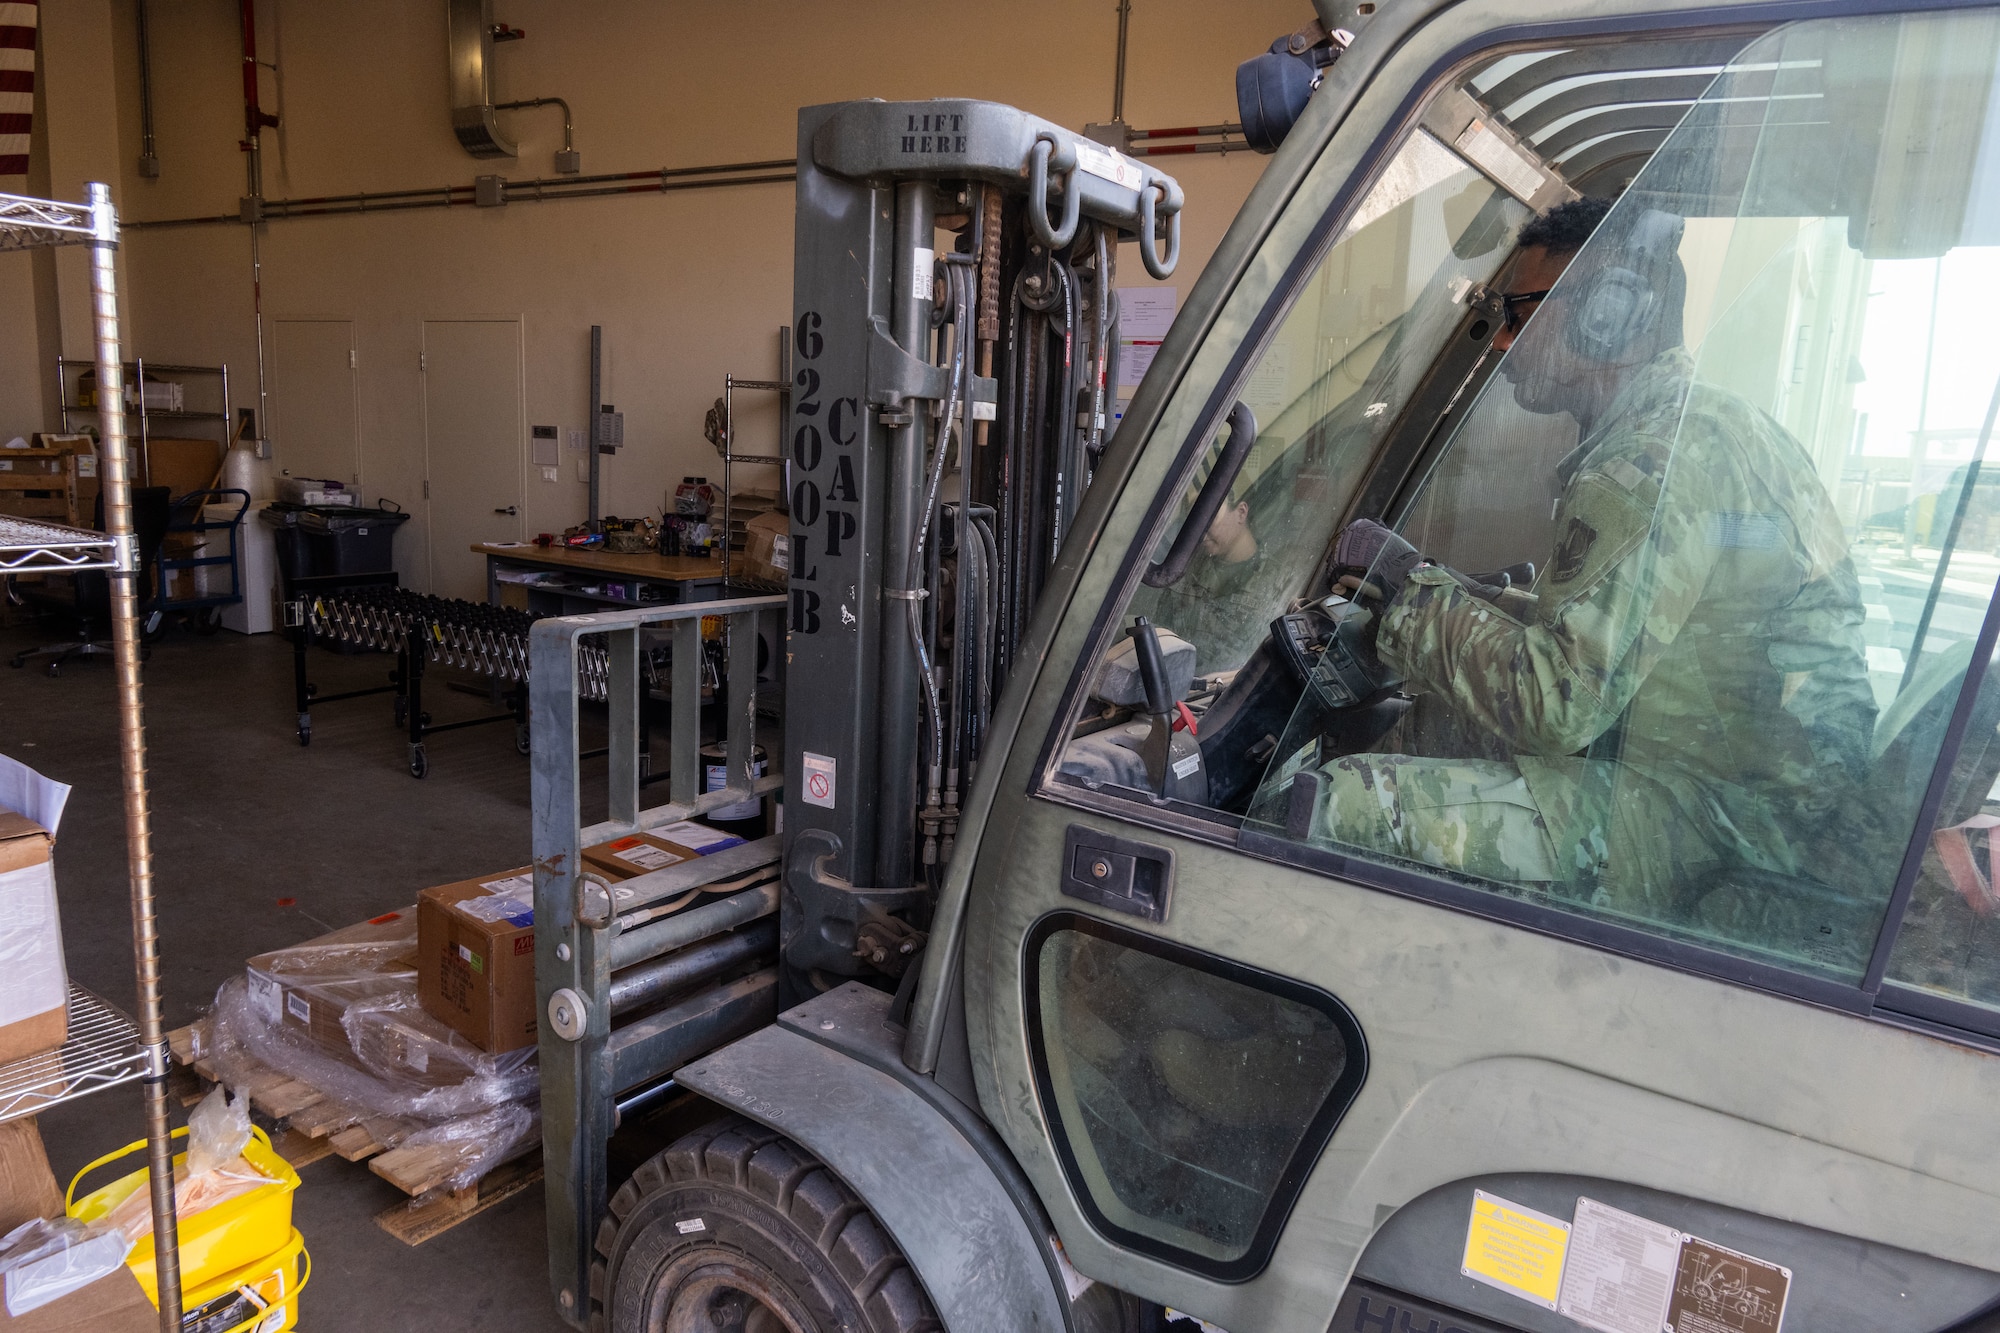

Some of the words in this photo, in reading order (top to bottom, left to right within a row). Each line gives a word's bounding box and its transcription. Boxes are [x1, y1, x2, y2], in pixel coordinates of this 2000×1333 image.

[907, 114, 963, 132] LIFT
[901, 136, 967, 153] HERE
[825, 397, 859, 557] CAP
[1480, 1223, 1520, 1242] OPERATOR
[1506, 1214, 1549, 1236] WARNING
[1488, 1235, 1535, 1257] PROTECTION
[1483, 1252, 1524, 1272] OPERATING
